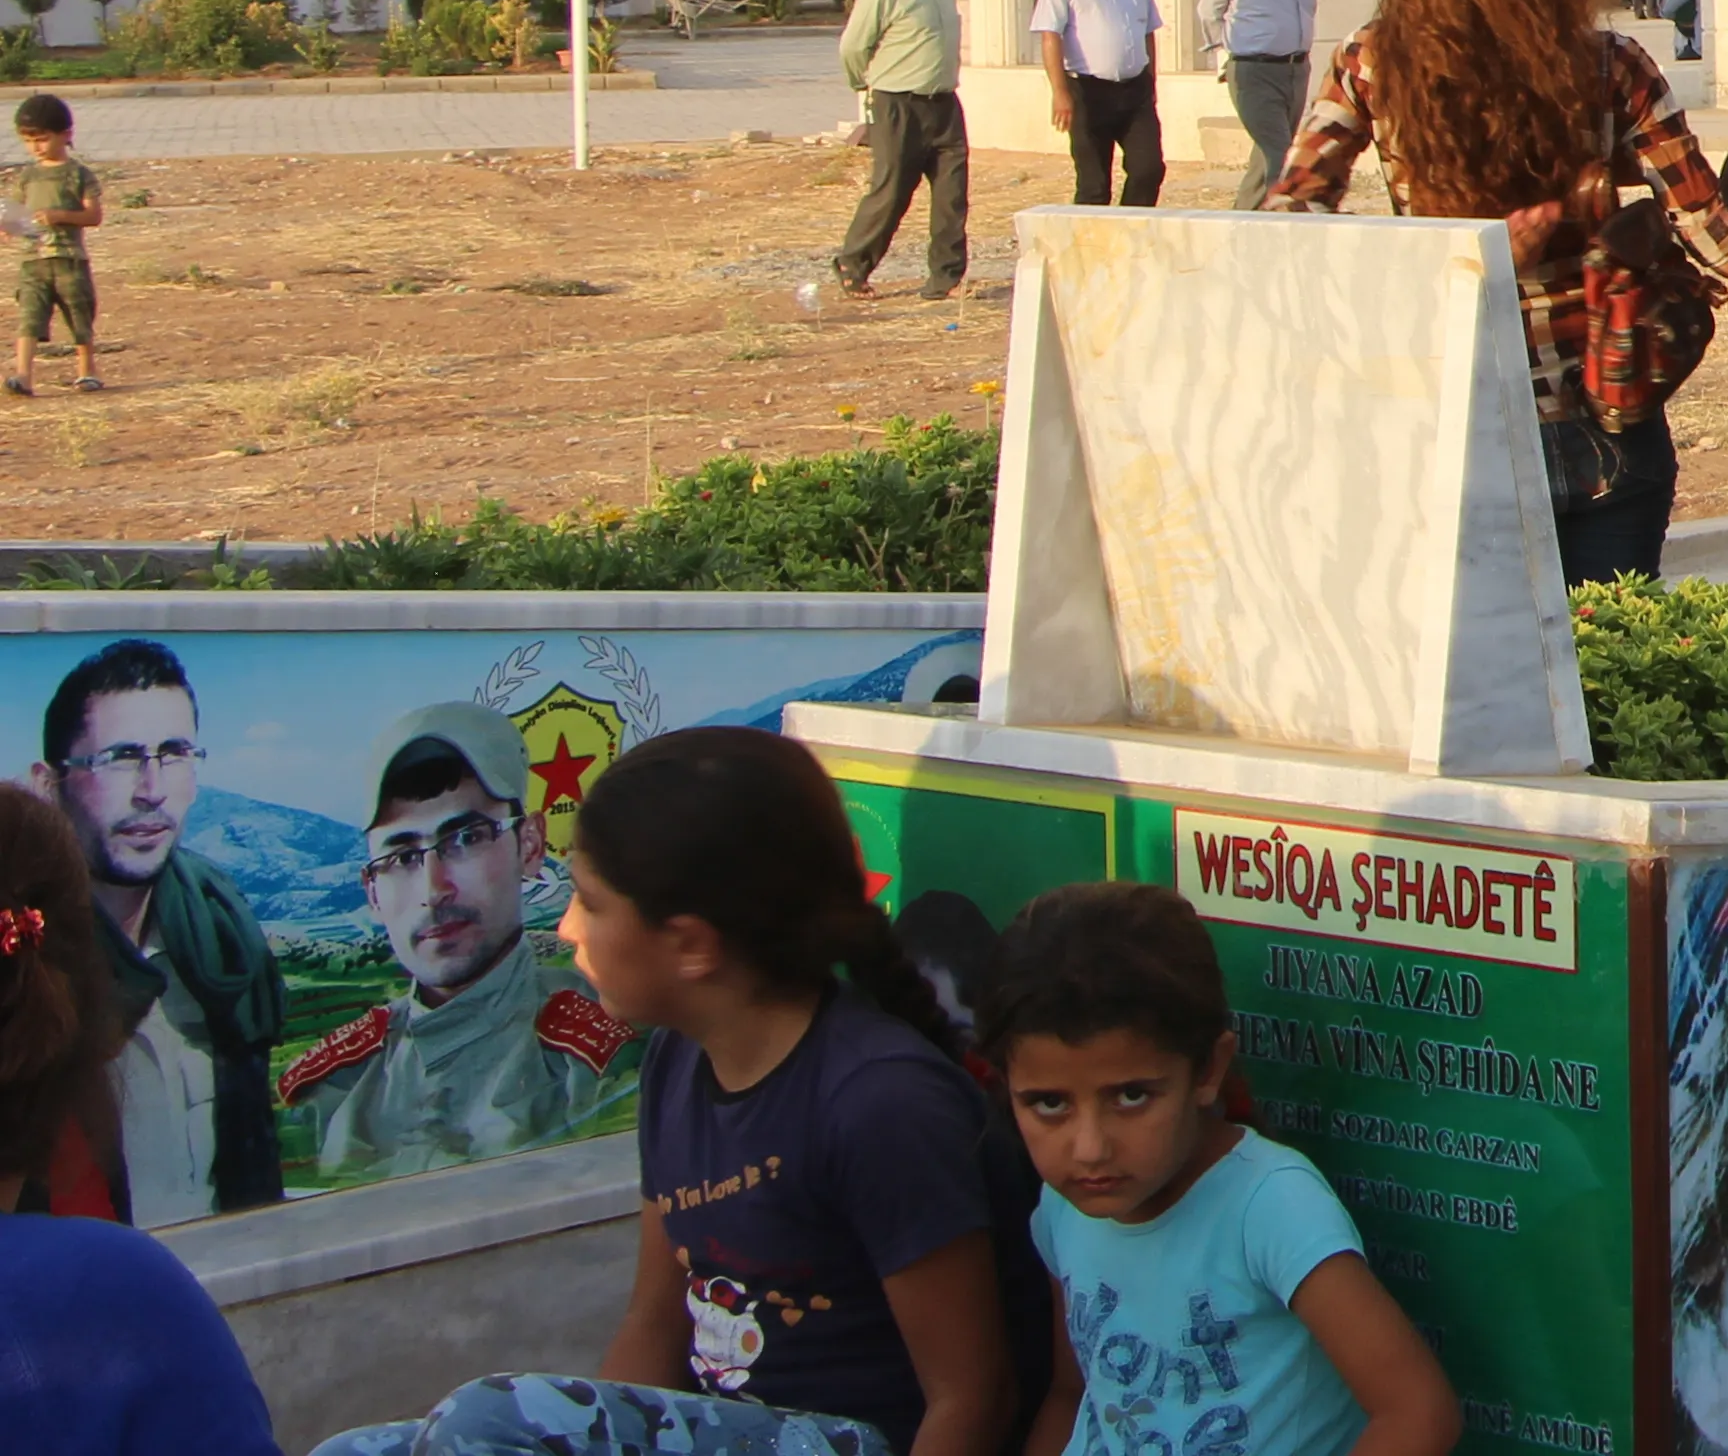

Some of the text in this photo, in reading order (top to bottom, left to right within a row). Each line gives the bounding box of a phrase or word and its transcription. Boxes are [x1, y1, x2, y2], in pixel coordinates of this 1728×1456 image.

[549, 801, 576, 816] 2015
[1193, 825, 1558, 943] WESÎQA ŞEHADETÊ
[1263, 943, 1485, 1019] JIYANA AZAD
[1231, 1010, 1324, 1067] HEMA
[1327, 1014, 1413, 1083] VÎNA
[1330, 1106, 1431, 1154] SOZDAR
[1435, 1126, 1543, 1175] GARZAN
[702, 1175, 742, 1203] Love
[1450, 1192, 1521, 1235] EBDÊ
[1517, 1411, 1615, 1455] AMÛDÊ
